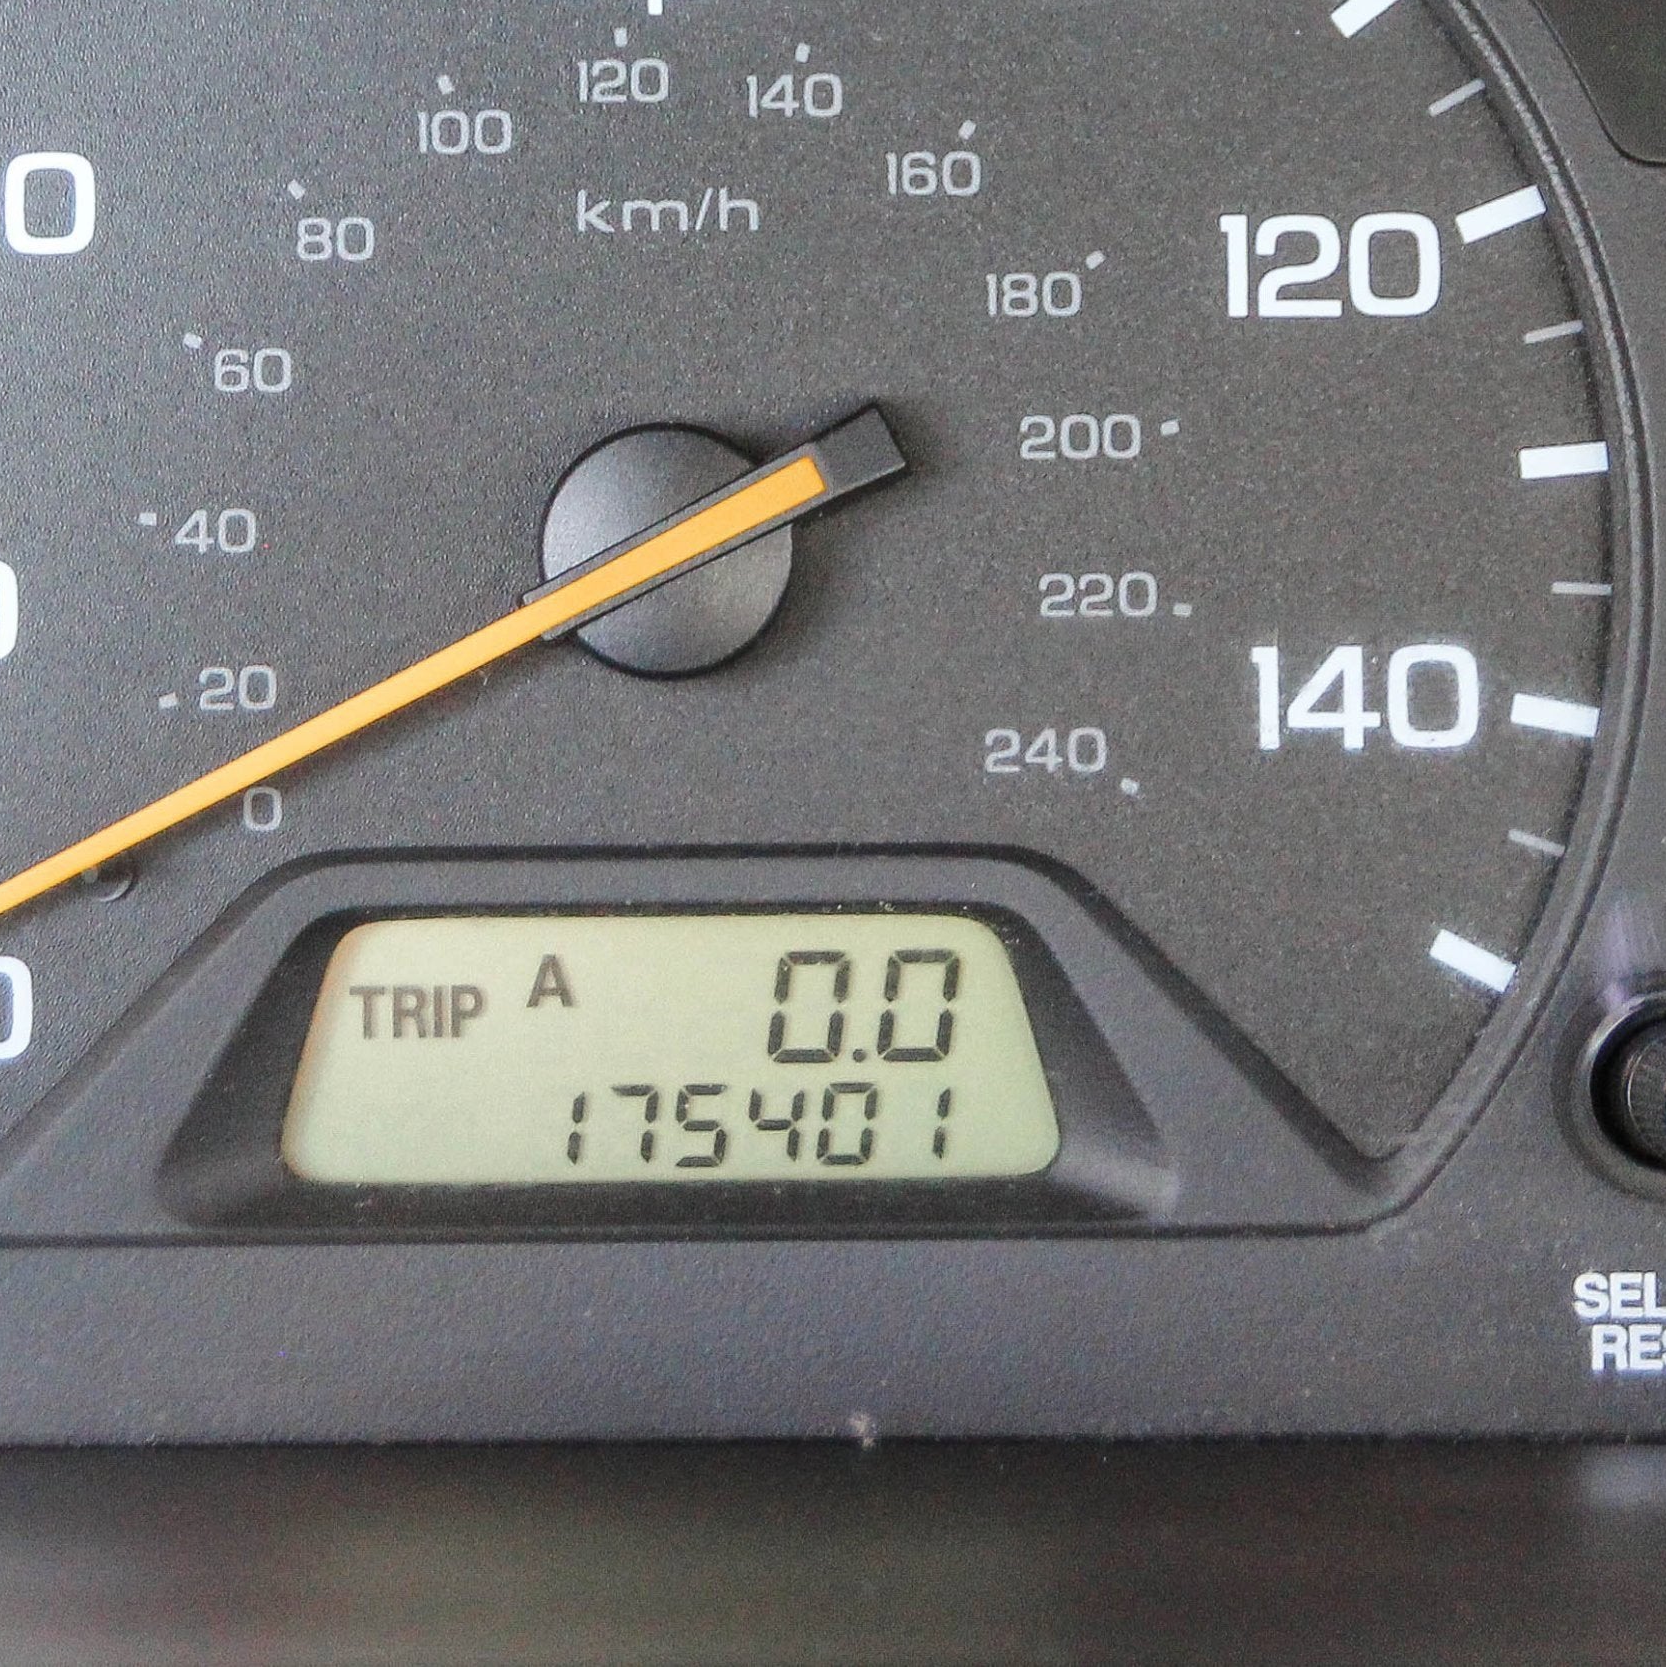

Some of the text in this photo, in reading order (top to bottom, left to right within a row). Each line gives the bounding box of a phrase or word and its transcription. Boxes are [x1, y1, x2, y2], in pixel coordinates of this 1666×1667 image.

[578, 59, 668, 102] 120
[747, 74, 842, 117] 140
[418, 110, 512, 154] 100
[887, 151, 980, 195] 160
[577, 188, 758, 232] km/h
[297, 217, 374, 261] 80
[1221, 213, 1439, 317] 120
[987, 272, 1081, 316] 180
[215, 348, 291, 392] 60
[1021, 414, 1140, 459] 200
[175, 509, 256, 553] 40
[1040, 572, 1156, 617] 220
[199, 666, 276, 710] 20
[1251, 644, 1479, 750] 140
[985, 727, 1106, 773] 240
[242, 786, 282, 831] 0
[350, 950, 961, 1064] TRIP A 0.0
[567, 1082, 952, 1168] 175401
